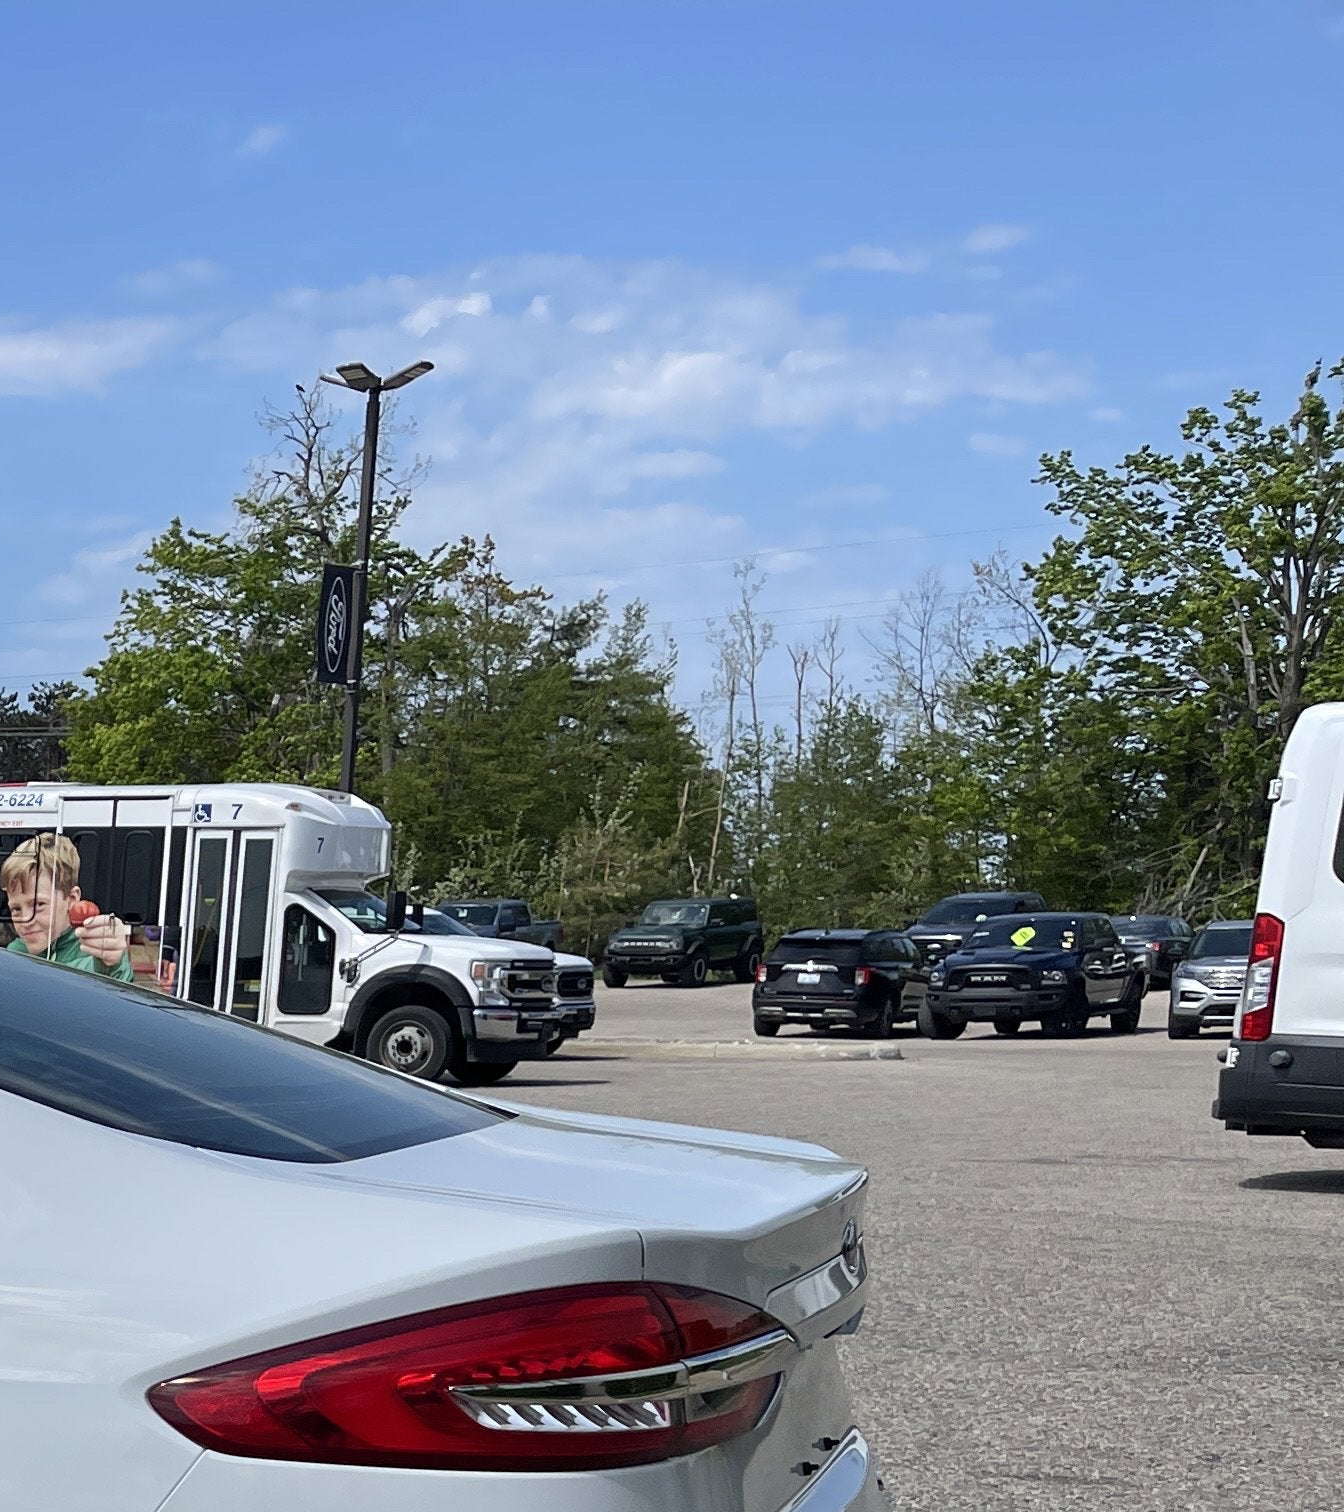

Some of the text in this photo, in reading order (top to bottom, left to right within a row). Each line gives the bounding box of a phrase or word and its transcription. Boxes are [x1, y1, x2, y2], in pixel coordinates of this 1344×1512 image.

[327, 593, 345, 656] Ford
[231, 803, 244, 820] 7
[317, 837, 325, 853] 7
